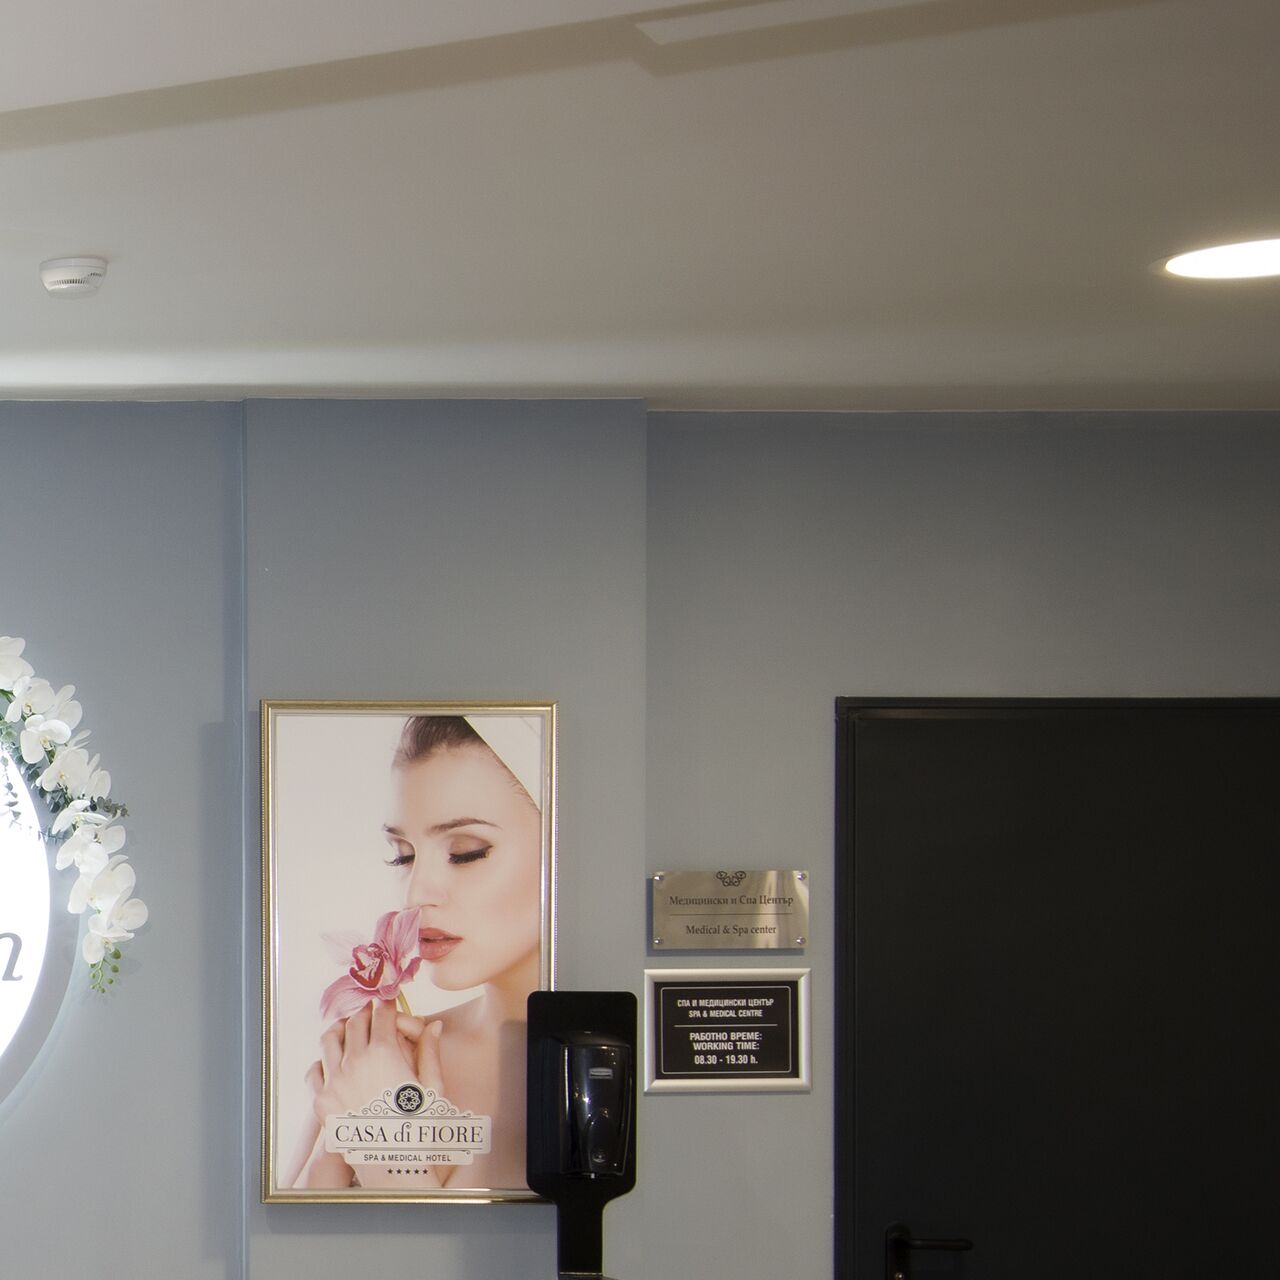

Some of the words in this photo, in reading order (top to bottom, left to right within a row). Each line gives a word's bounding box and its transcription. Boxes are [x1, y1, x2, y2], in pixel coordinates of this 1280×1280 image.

[669, 895, 728, 906] Медицински
[731, 897, 737, 905] и
[739, 895, 757, 905] Спа
[759, 895, 794, 907] Център
[686, 924, 720, 935] Medical
[722, 925, 731, 935] &
[733, 924, 748, 936] Spa
[750, 925, 776, 934] center
[677, 999, 690, 1007] СПА
[692, 999, 697, 1007] И
[699, 999, 746, 1008] МЕДИЦИНСКИ
[748, 998, 774, 1007] ЦЕНТЪР
[688, 1010, 701, 1018] SPA
[702, 1010, 708, 1018] &
[738, 1009, 763, 1017] CENTRE
[689, 1032, 728, 1041] РАБОТНО
[730, 1032, 763, 1040] ВРЕМЕ:
[693, 1042, 733, 1050] WORKING
[736, 1042, 760, 1050] TIME:
[694, 1055, 717, 1064] 08.30
[725, 1055, 748, 1064] 19.30
[750, 1055, 758, 1064] h.
[335, 1125, 388, 1143] CASA
[394, 1121, 413, 1143] di
[418, 1125, 484, 1143] FIORE
[364, 1154, 379, 1162] SPA
[381, 1154, 386, 1162] &
[388, 1154, 423, 1162] MEDICAL
[426, 1154, 452, 1162] HOTEL
